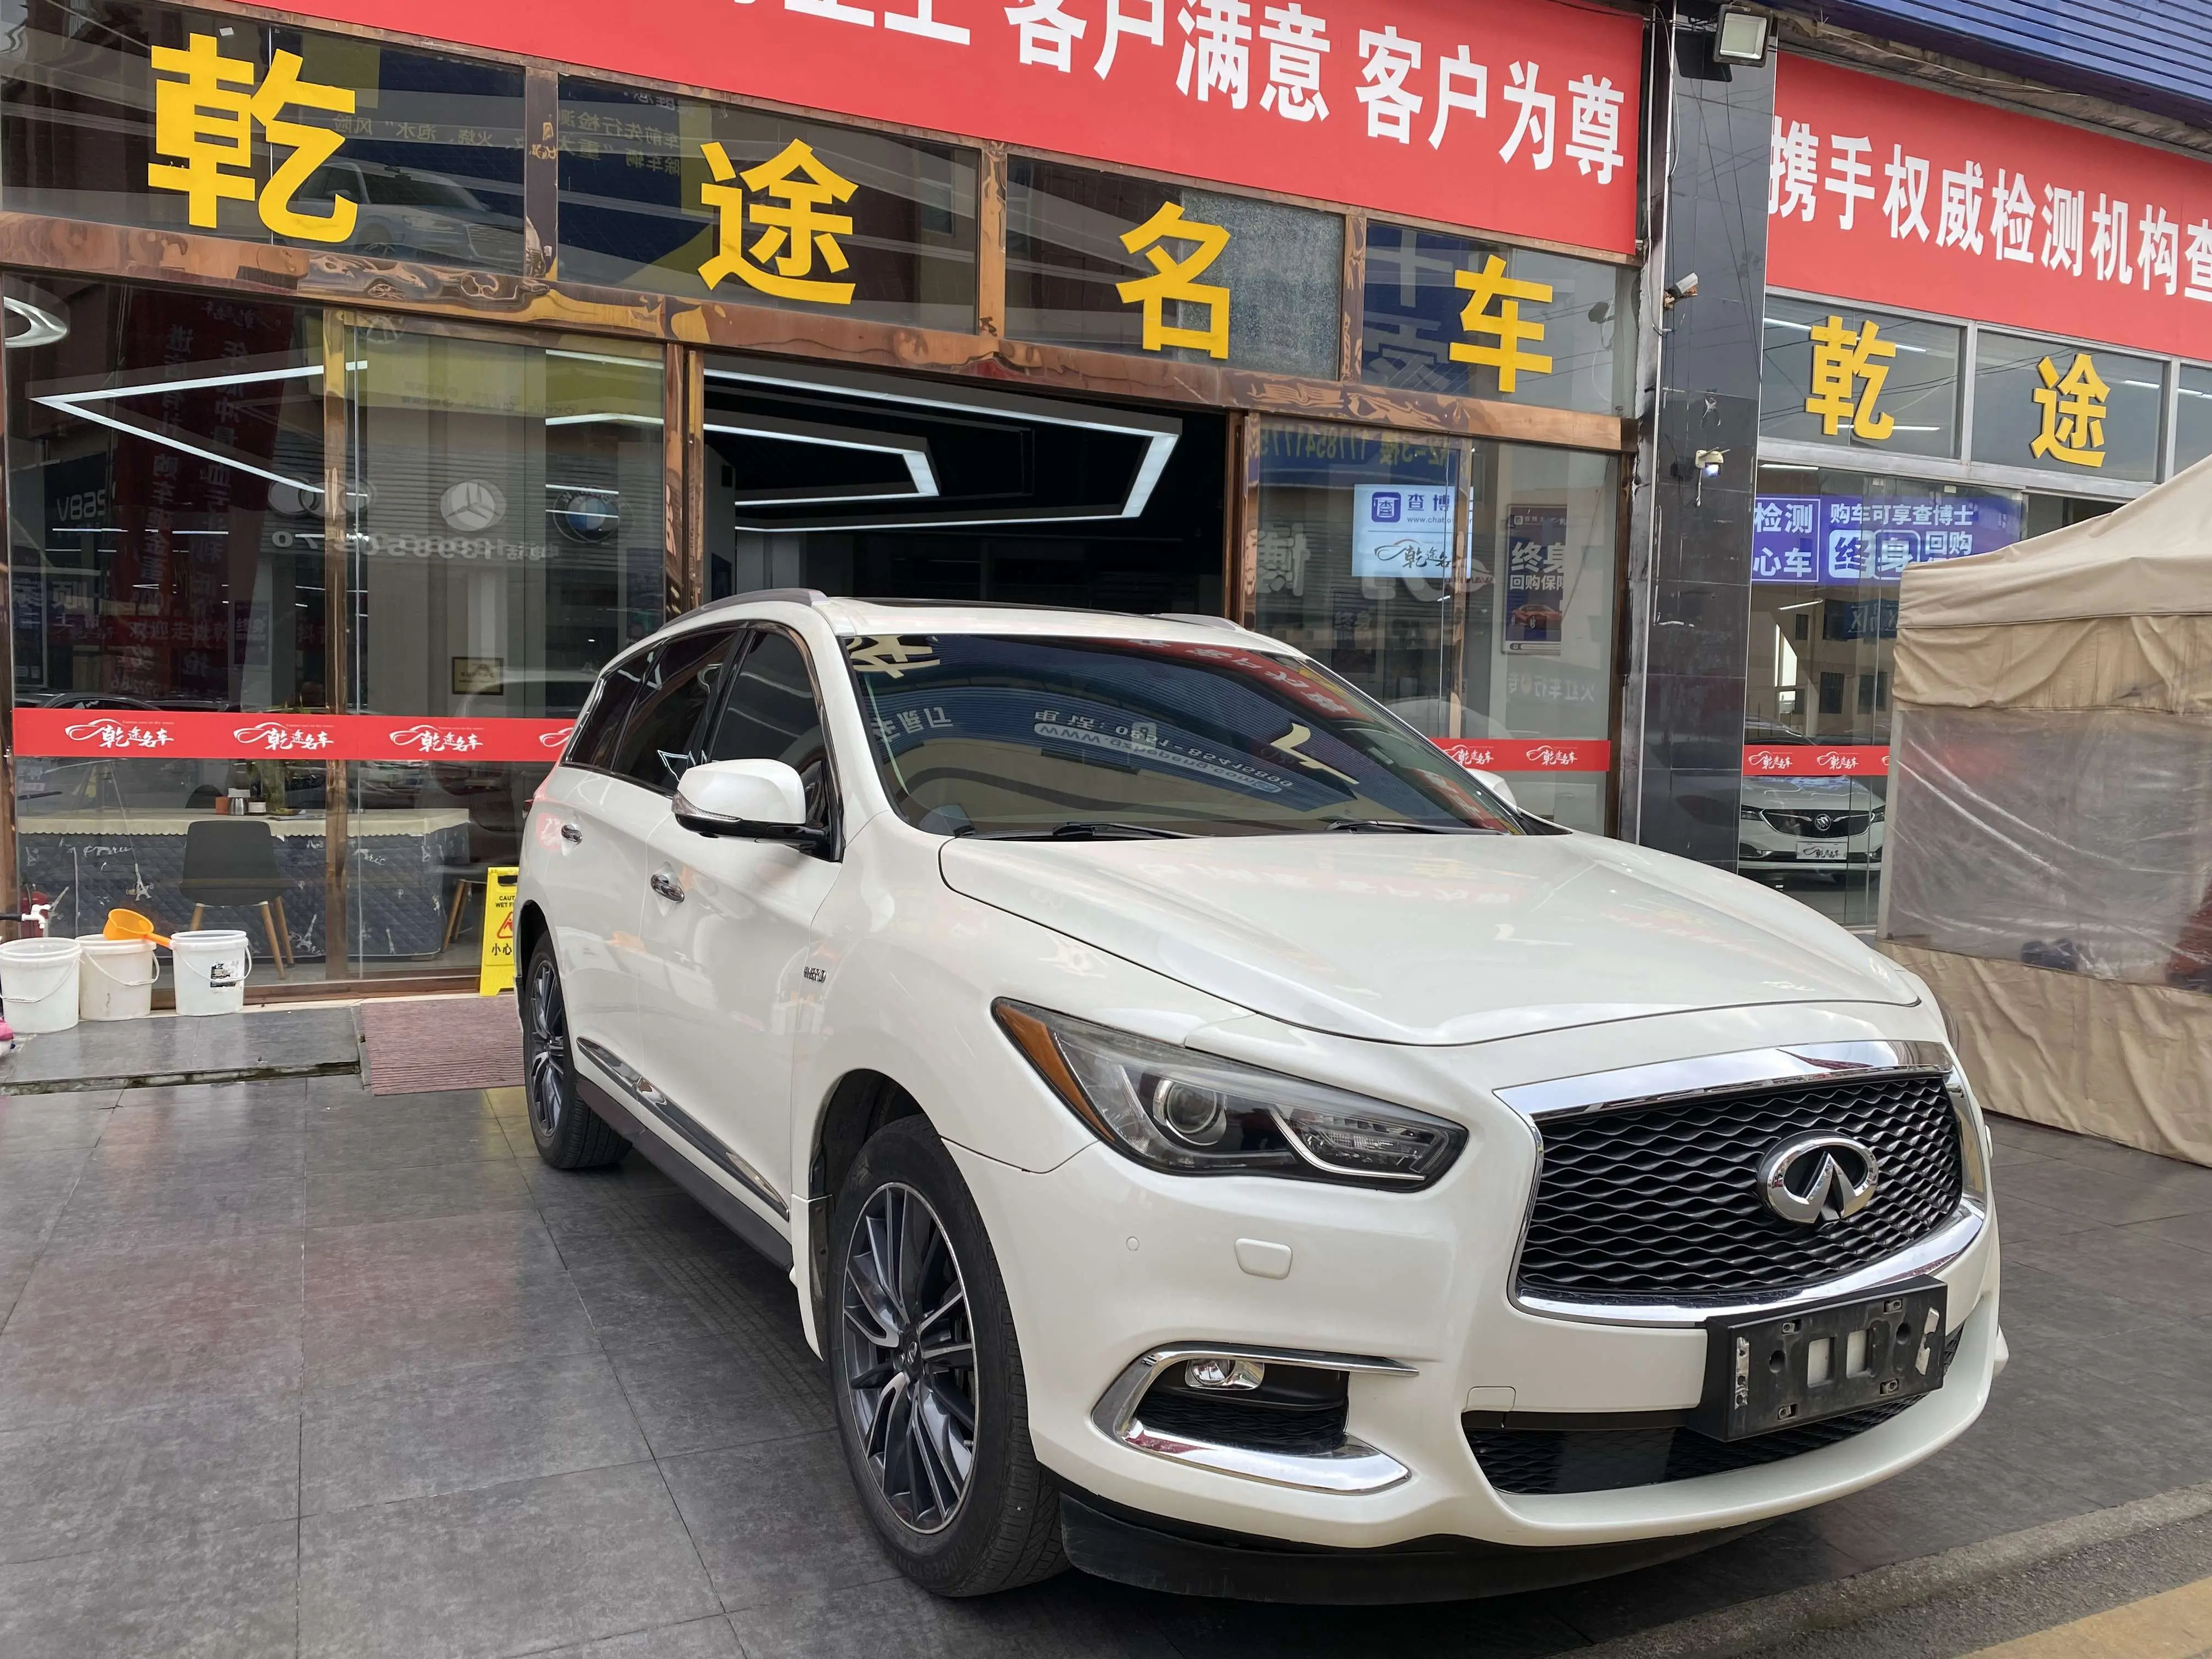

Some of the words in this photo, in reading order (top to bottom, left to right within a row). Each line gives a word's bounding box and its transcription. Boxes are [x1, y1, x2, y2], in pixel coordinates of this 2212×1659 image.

[1355, 26, 1624, 184] 客户为尊
[148, 33, 358, 242] 乾
[698, 138, 858, 304] 途
[1116, 201, 1230, 359] 名
[1449, 255, 1553, 393] 车
[1805, 315, 1896, 440] 乾
[2030, 353, 2111, 467] 途
[1407, 493, 1451, 512] 查博
[1830, 503, 1974, 526] 购车可享查博士
[1754, 503, 1814, 533] 检测
[1402, 545, 1452, 569] 乾途名
[1925, 531, 1973, 556] 回购
[1753, 547, 1812, 578] 心车
[492, 943, 512, 956] 小心
